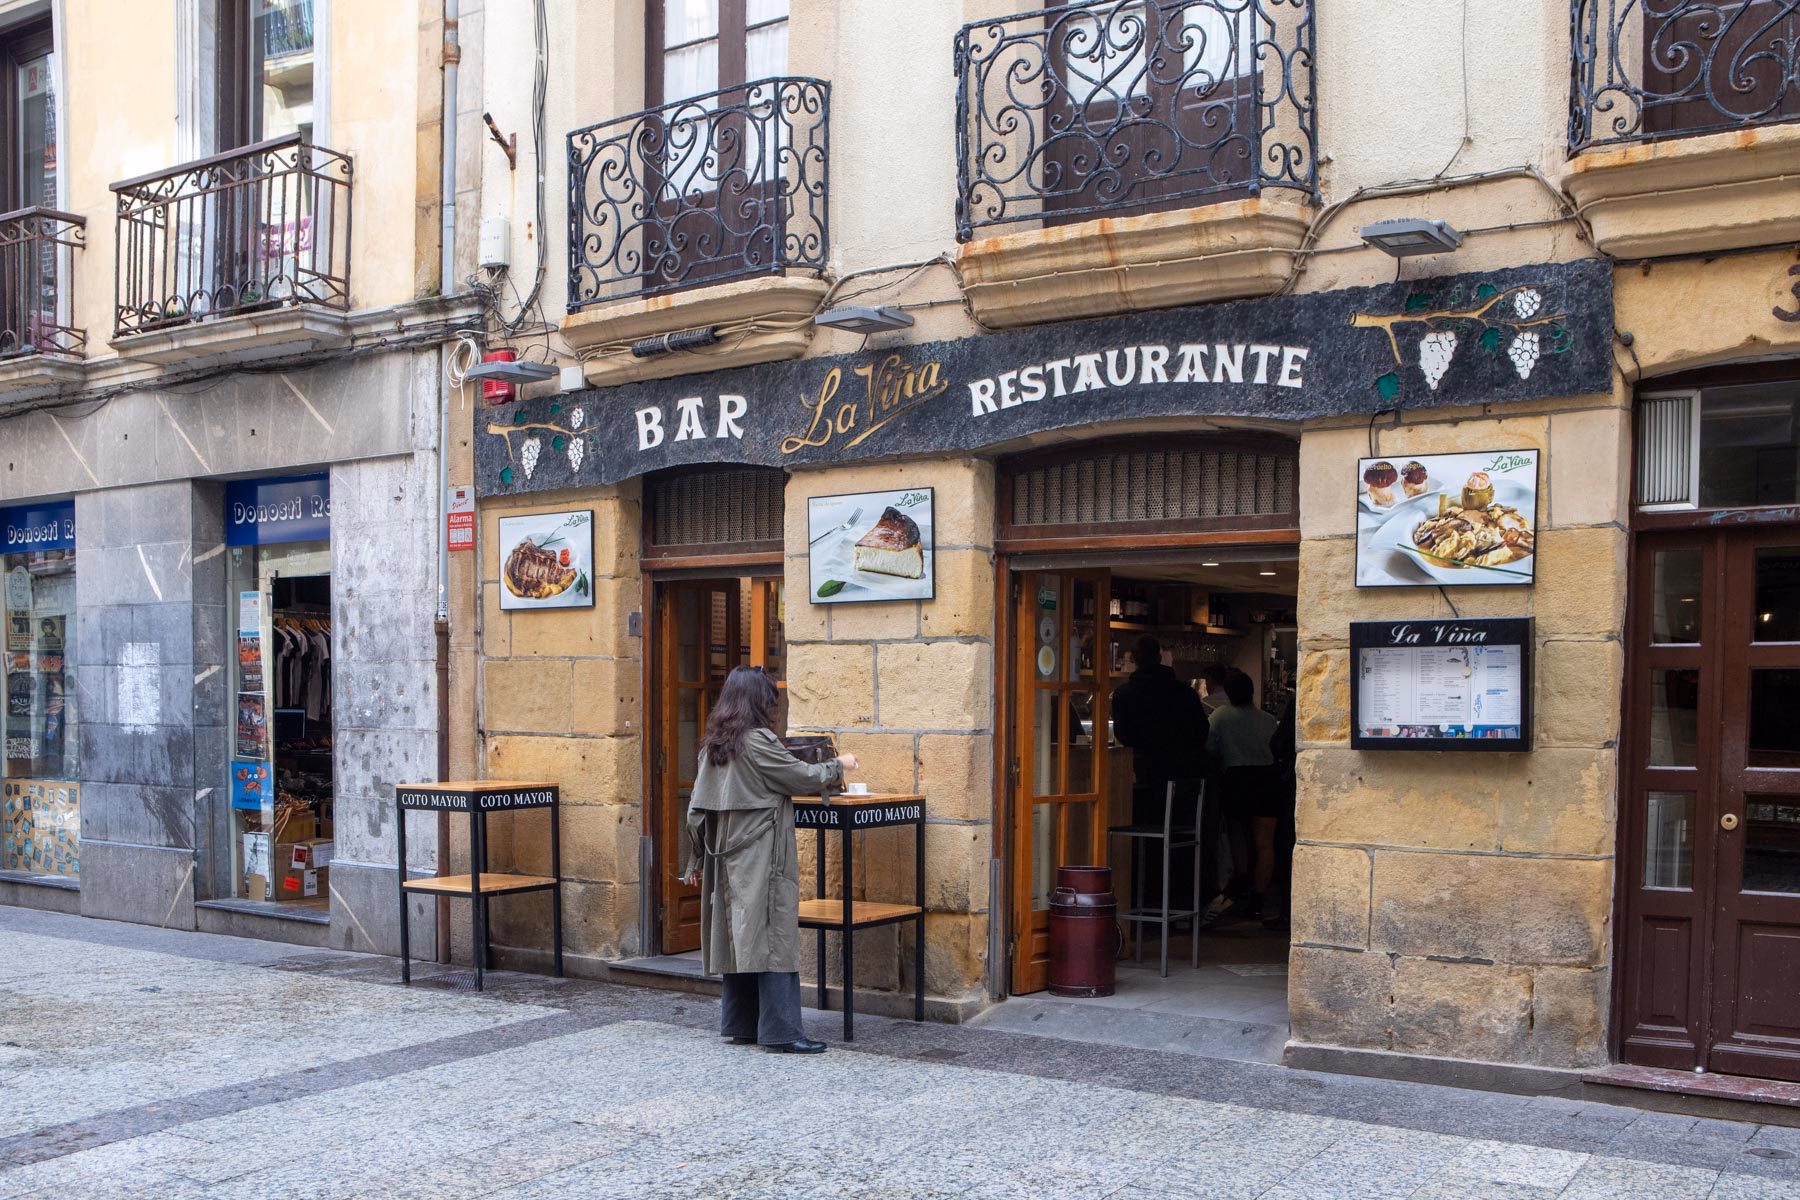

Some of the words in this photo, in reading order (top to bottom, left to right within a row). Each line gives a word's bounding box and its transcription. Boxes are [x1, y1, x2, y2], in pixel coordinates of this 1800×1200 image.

[635, 394, 748, 451] BAR
[781, 367, 857, 454] La
[852, 354, 948, 436] Viña
[968, 344, 1309, 418] RESTAURANTE
[1483, 455, 1508, 472] La
[1502, 455, 1533, 473] Viña
[234, 496, 302, 525] Donosti
[449, 515, 473, 524] Alarma
[7, 521, 58, 545] Donosti
[1388, 624, 1421, 644] La
[1431, 623, 1488, 644] Viña
[401, 793, 428, 806] COTO
[431, 795, 467, 808] MAYOR
[480, 794, 511, 808] COTO
[514, 791, 553, 805] MAYOR
[854, 809, 882, 824] COTO
[885, 805, 920, 822] MAYOR
